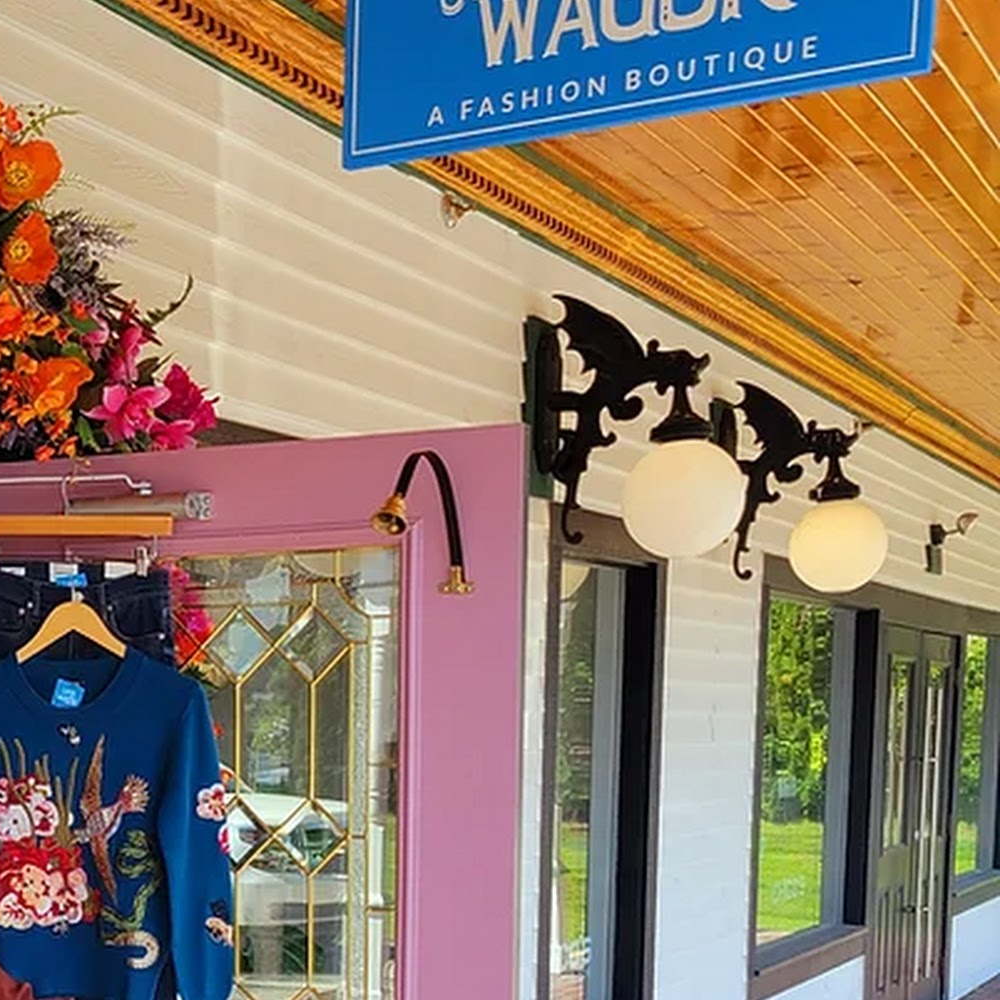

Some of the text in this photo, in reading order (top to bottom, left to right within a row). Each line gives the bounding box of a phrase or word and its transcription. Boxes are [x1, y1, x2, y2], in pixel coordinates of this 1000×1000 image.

[427, 36, 818, 126] A FASHION BOUTIQUE
